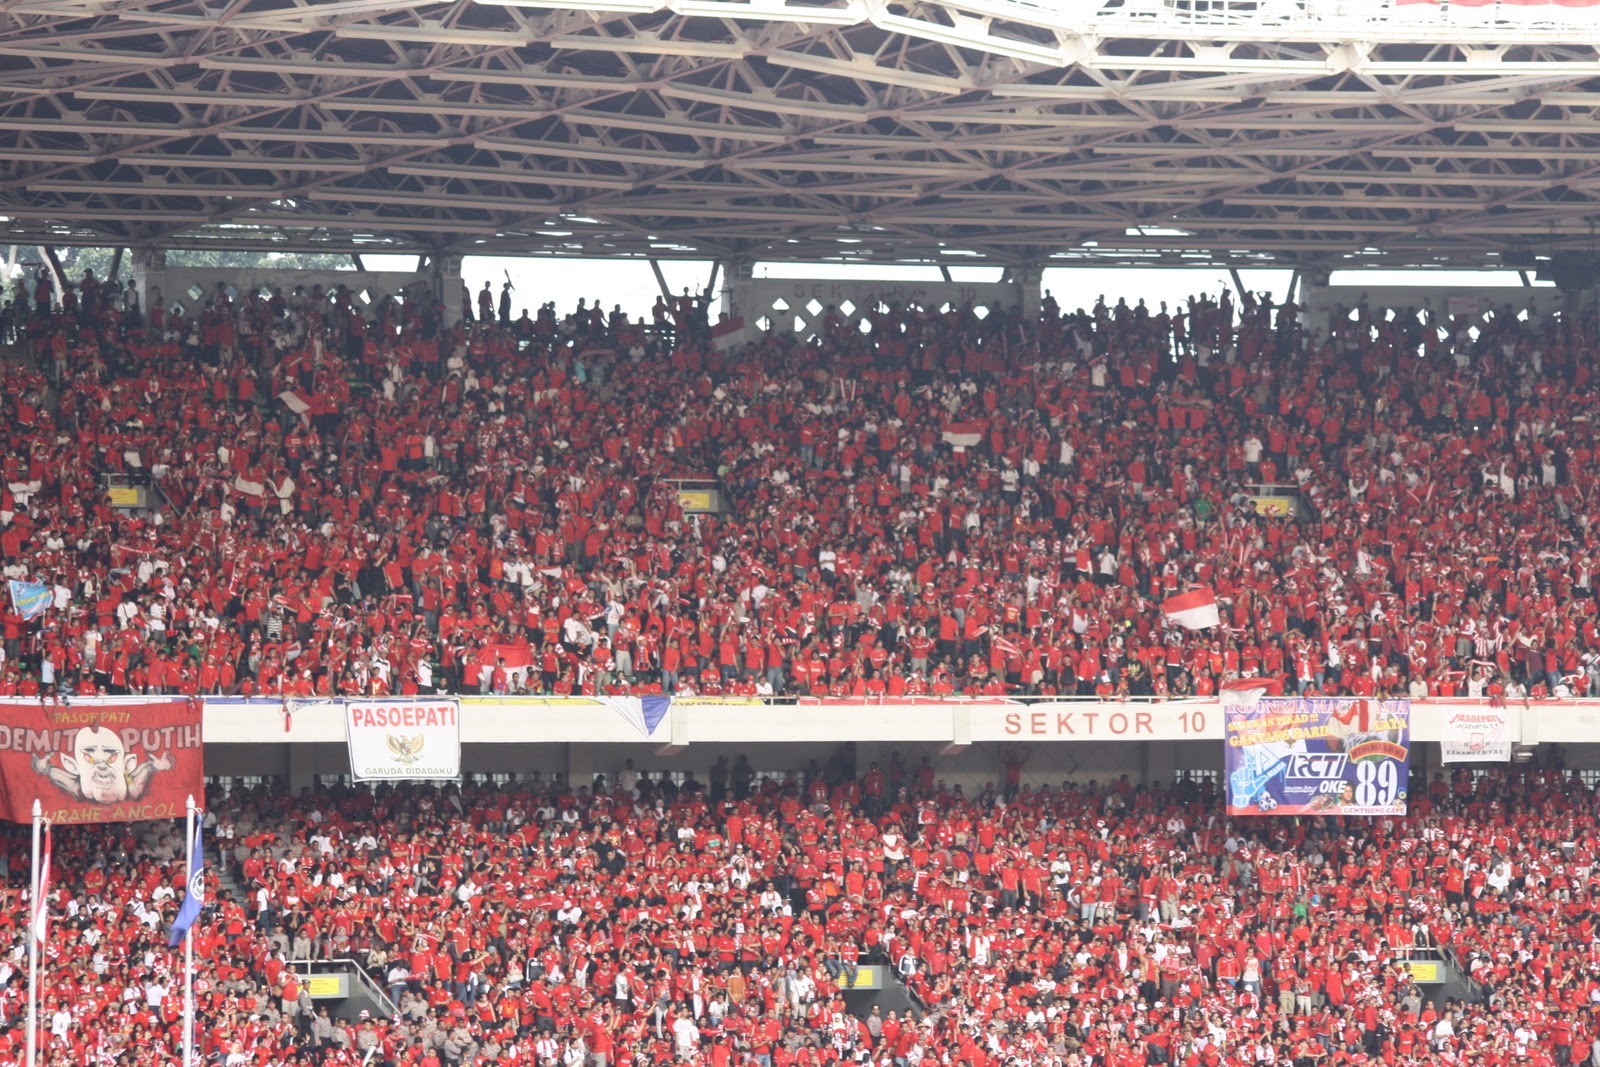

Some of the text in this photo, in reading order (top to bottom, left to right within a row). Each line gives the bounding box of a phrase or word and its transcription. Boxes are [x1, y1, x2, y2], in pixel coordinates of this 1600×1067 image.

[352, 706, 456, 728] PASOEPATI
[1005, 711, 1206, 735] SEKTOR 10
[1449, 713, 1505, 724] PASOEPATI
[0, 722, 201, 753] DEMIT PUTIH
[405, 767, 453, 775] DIDADAKU
[1286, 753, 1348, 779] RCTI
[1319, 780, 1347, 794] OKE
[1355, 760, 1399, 806] 89
[42, 802, 177, 823] URAHE ANCOL
